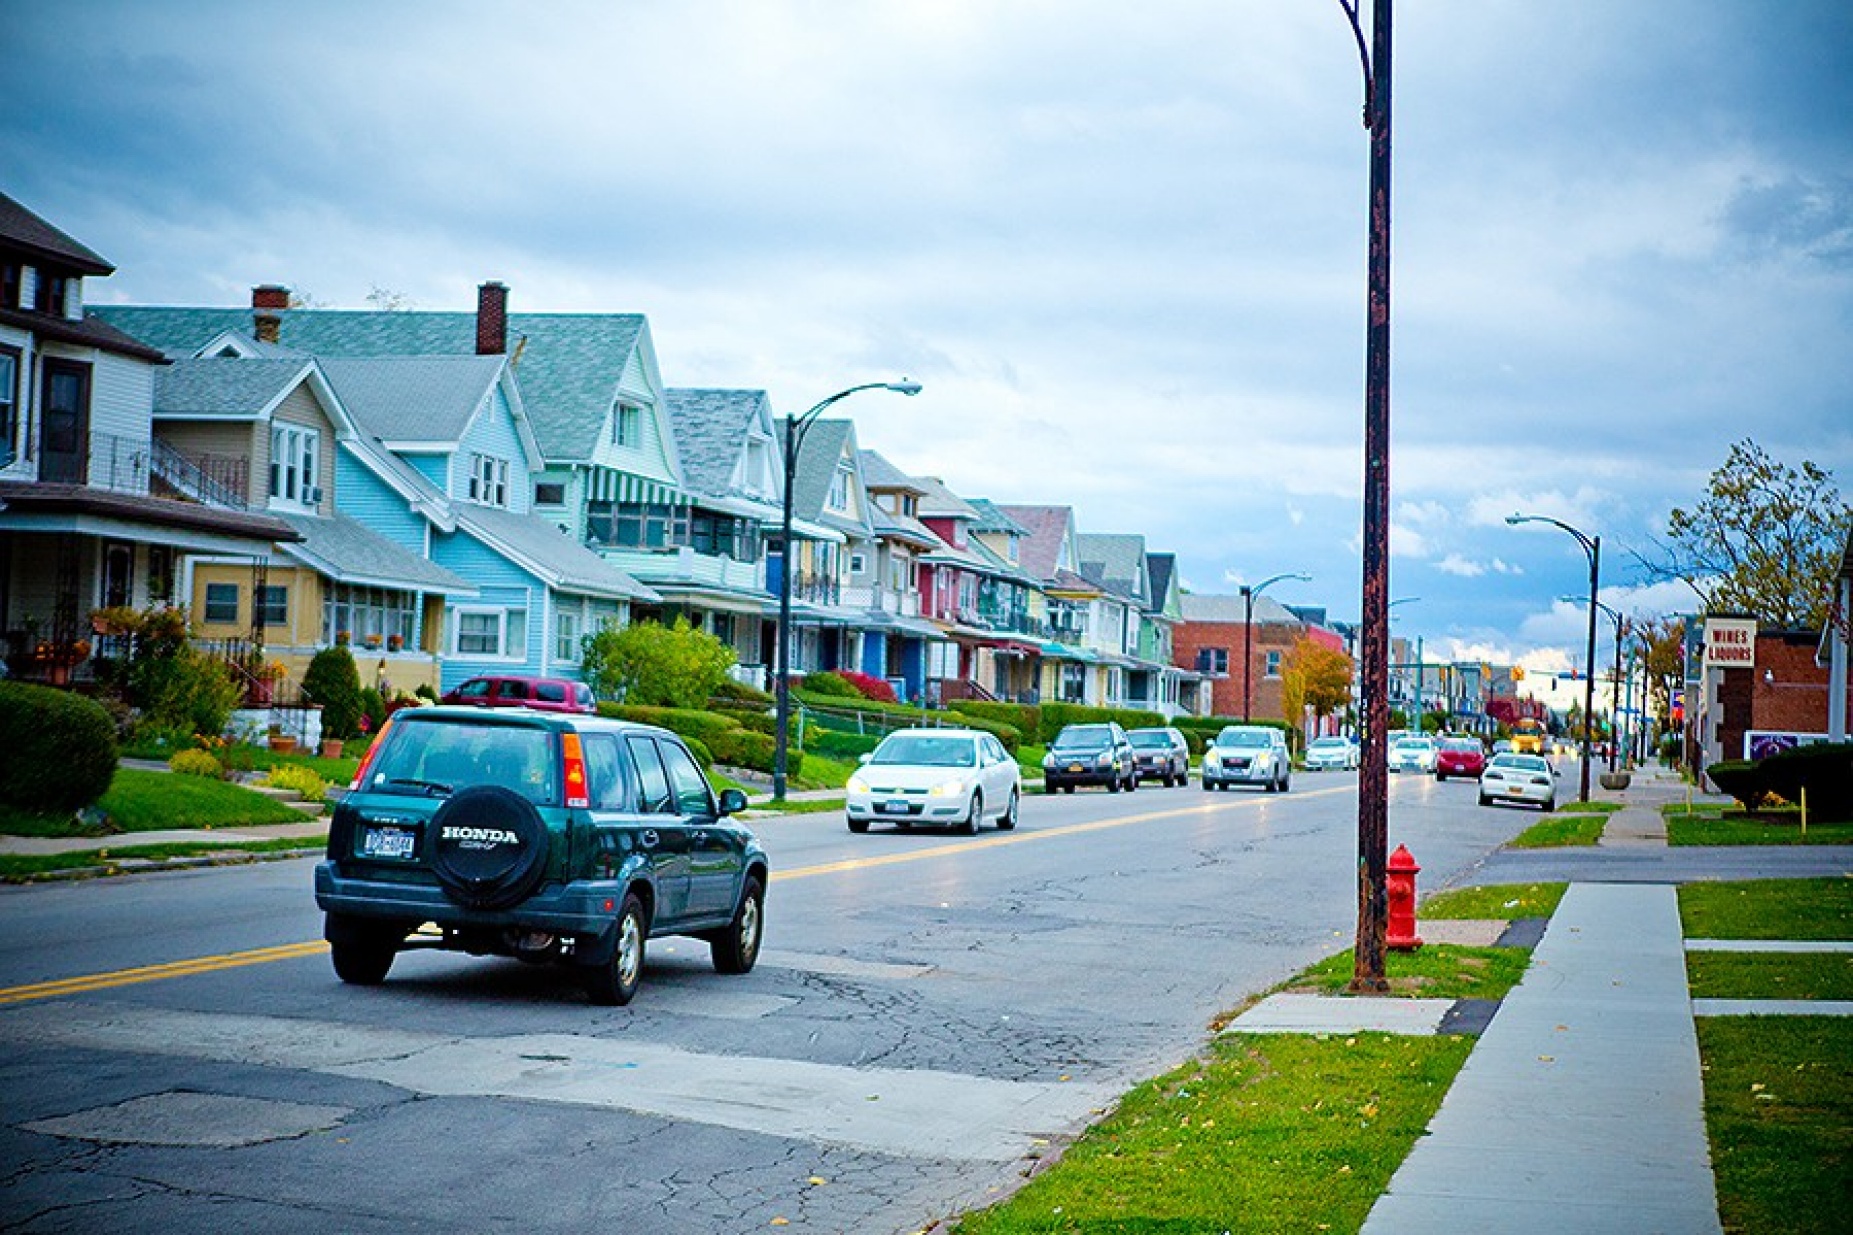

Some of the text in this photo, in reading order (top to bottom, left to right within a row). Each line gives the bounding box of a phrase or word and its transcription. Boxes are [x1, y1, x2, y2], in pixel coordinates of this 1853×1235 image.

[1713, 629, 1747, 643] WINES
[1709, 647, 1750, 661] LIQUORS
[442, 826, 519, 844] HONDA
